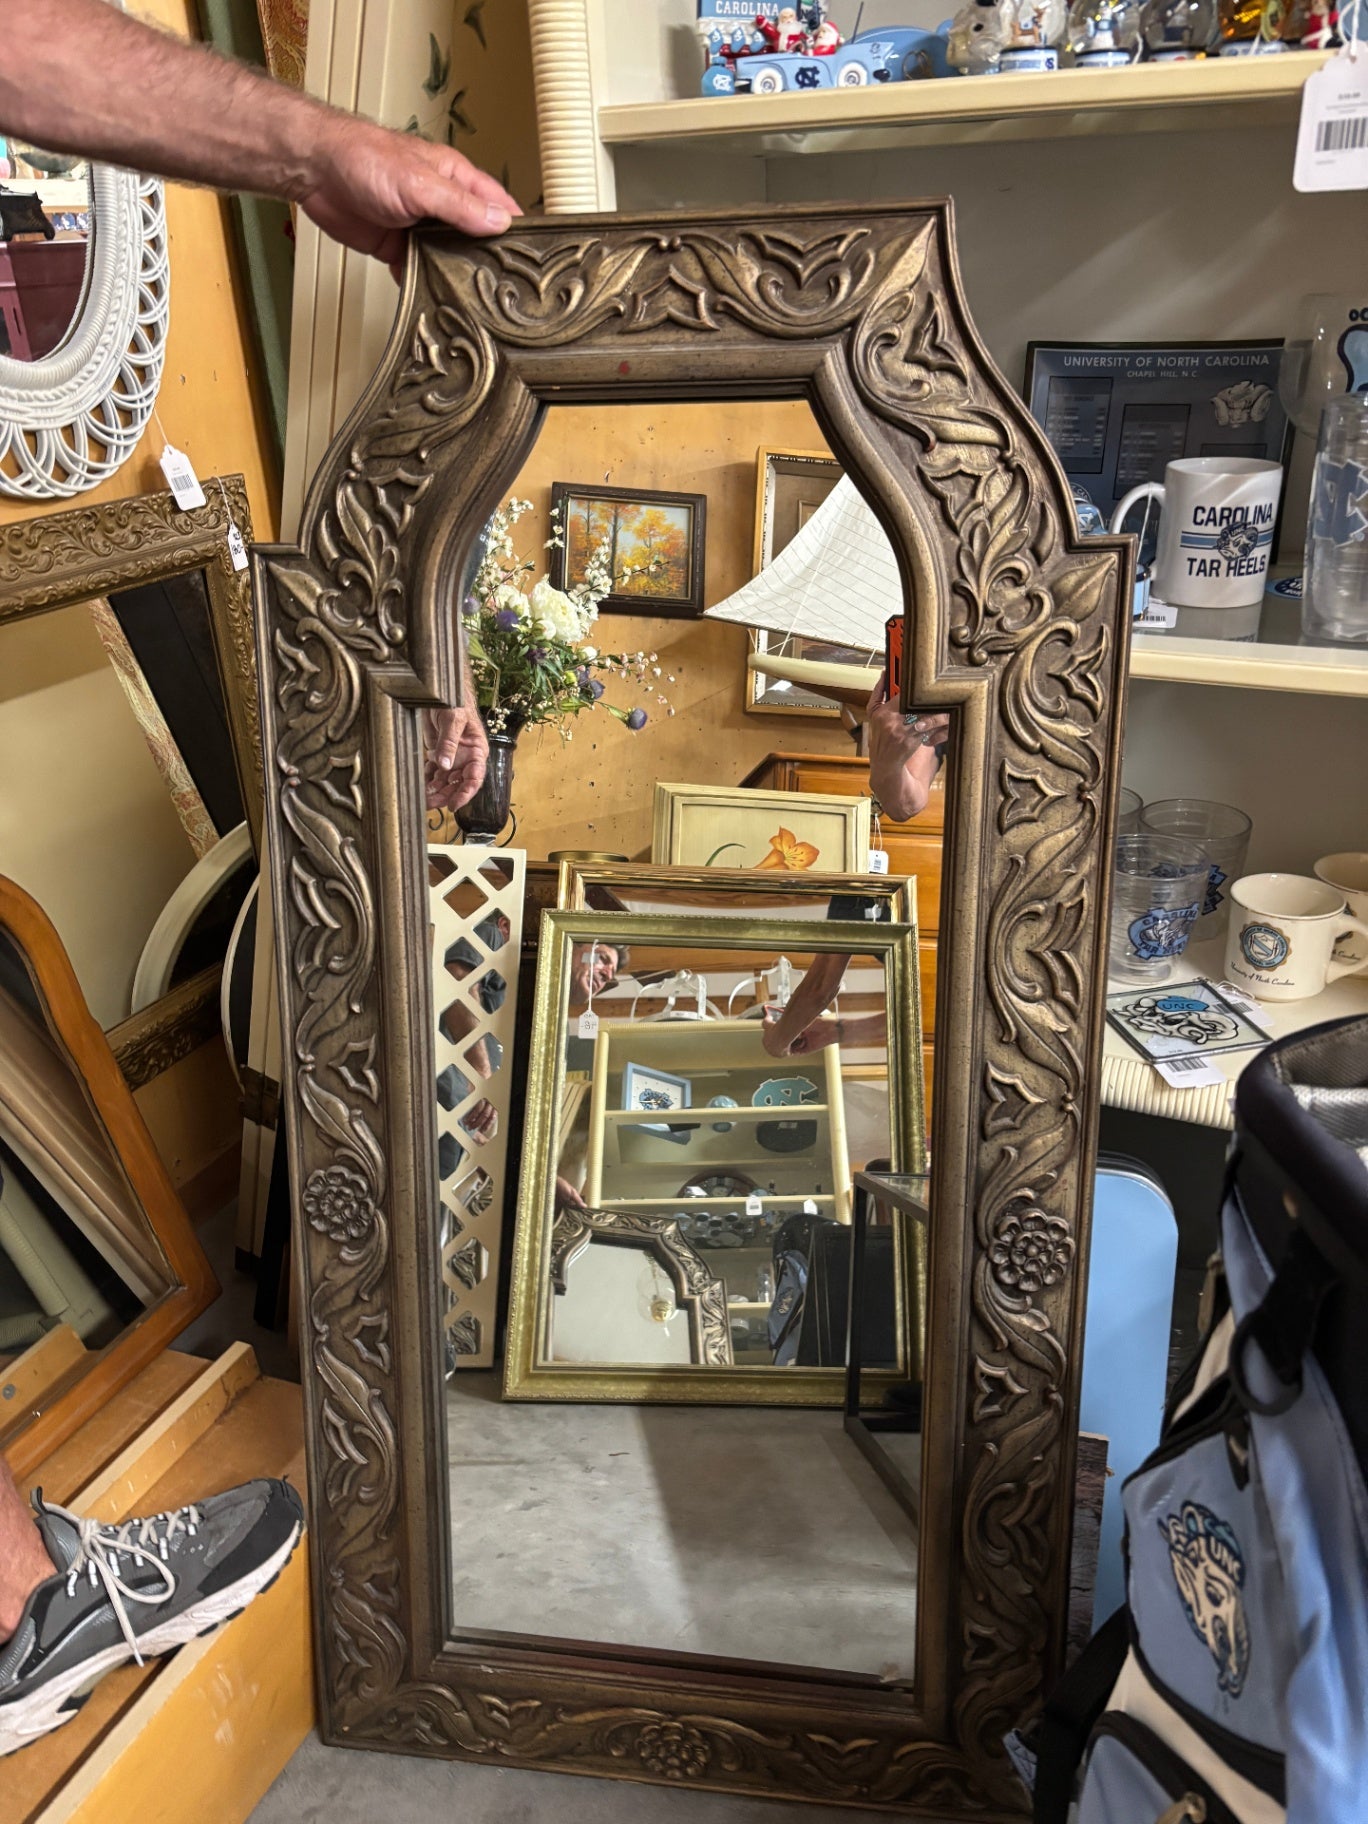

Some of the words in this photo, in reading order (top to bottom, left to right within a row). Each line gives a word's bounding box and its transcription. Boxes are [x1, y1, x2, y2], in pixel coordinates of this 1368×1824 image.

[715, 0, 780, 16] CAROLINA
[1064, 356, 1131, 368] UNIVERSITY
[1135, 356, 1153, 367] OF
[1157, 356, 1199, 367] NORTH
[1205, 355, 1270, 367] CAROLINA
[1127, 370, 1156, 378] CHAPEL
[1192, 503, 1273, 527] CAROLINA
[1187, 557, 1221, 577] TAR
[1226, 554, 1267, 577] HEELS
[1209, 1535, 1241, 1581] UNC
